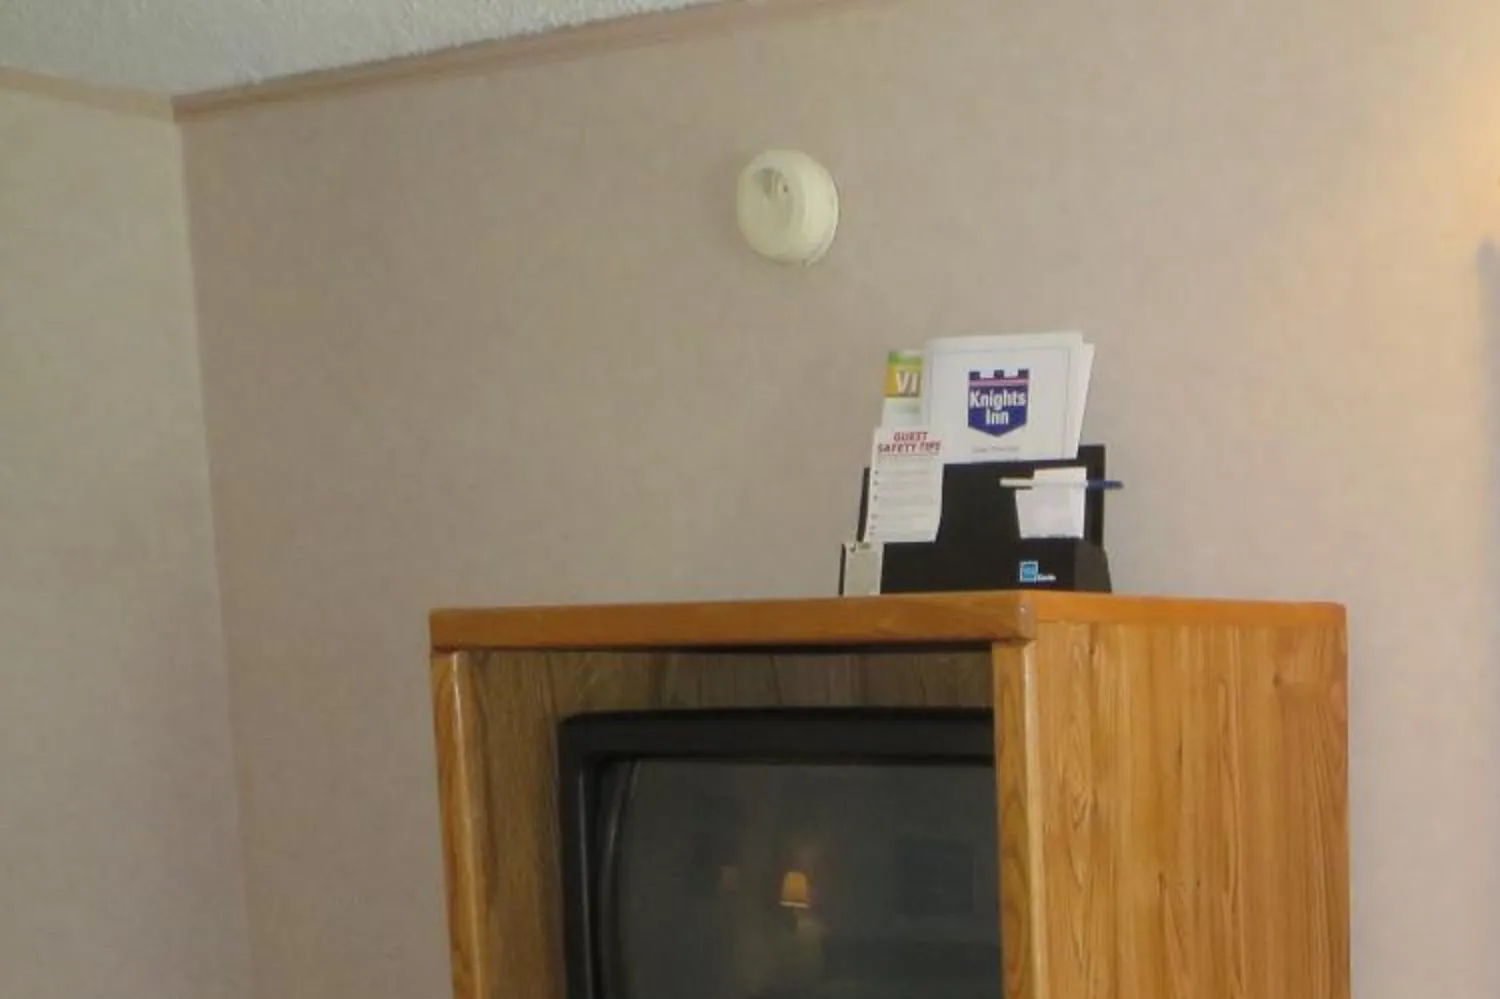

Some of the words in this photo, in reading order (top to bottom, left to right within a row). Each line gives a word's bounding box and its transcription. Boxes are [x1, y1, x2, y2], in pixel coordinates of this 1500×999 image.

[969, 388, 1026, 411] Knights
[986, 408, 1009, 424] Inn
[893, 431, 929, 442] GUEST
[878, 442, 918, 453] SAFETY
